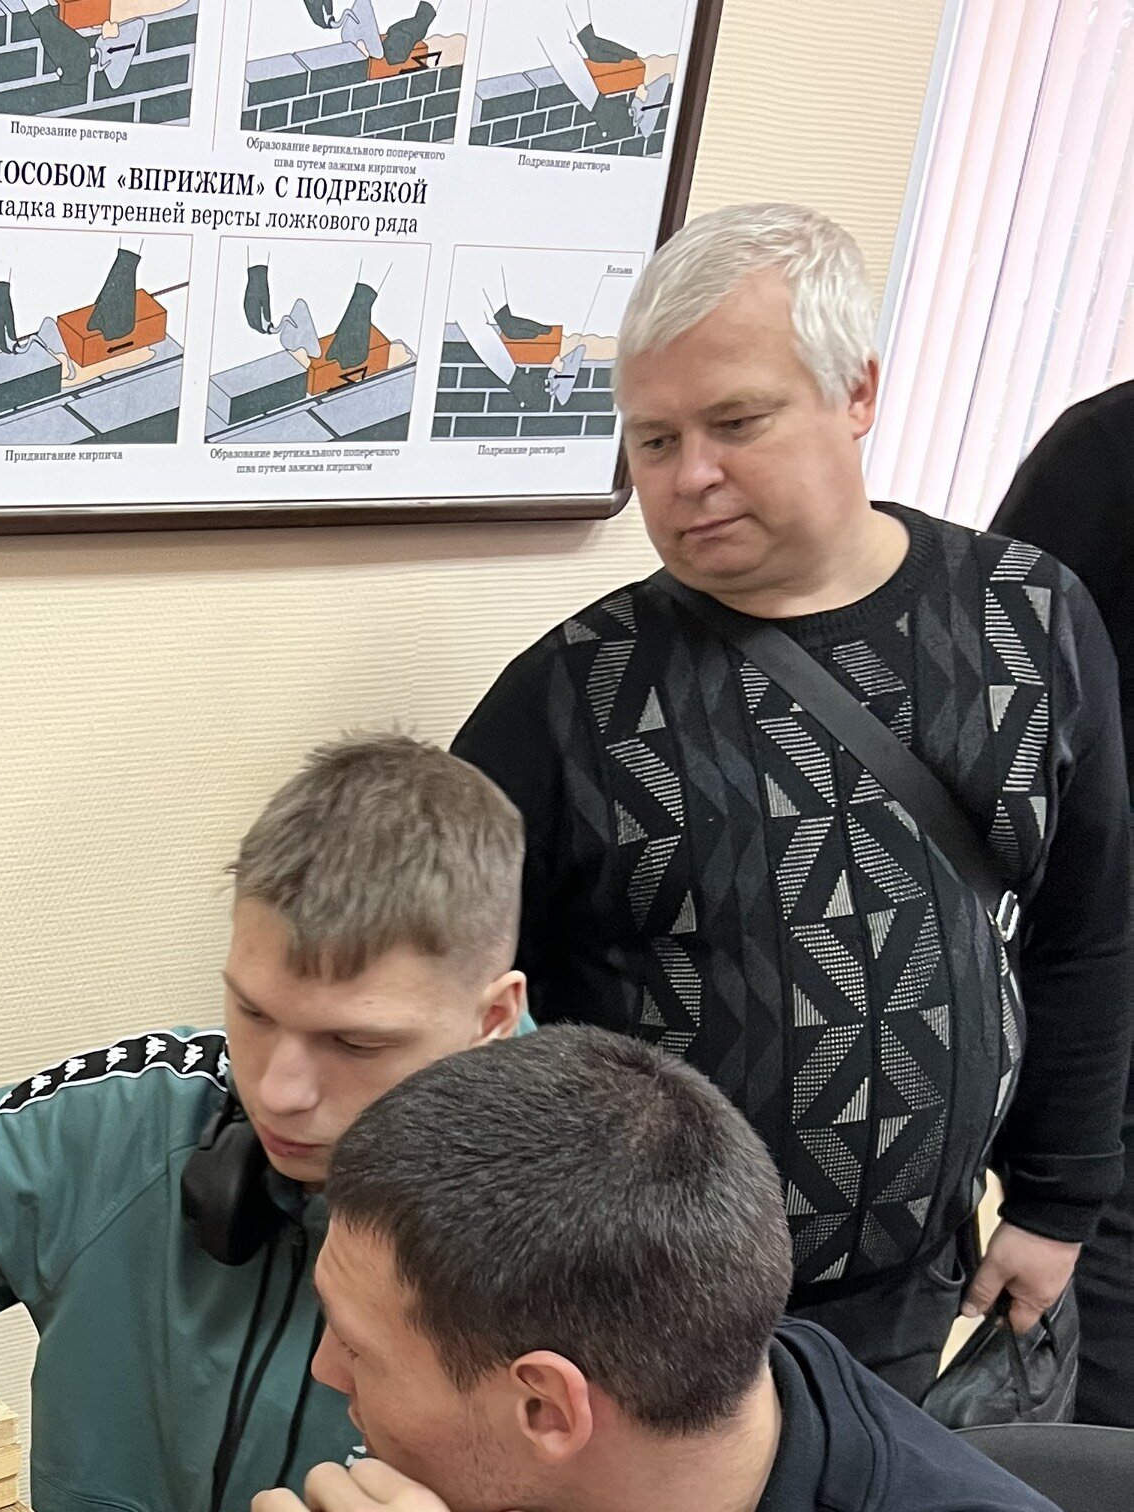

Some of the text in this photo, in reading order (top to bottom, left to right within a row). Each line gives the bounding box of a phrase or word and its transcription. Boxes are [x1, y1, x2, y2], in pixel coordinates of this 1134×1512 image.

[10, 120, 128, 143] Подрезание раствора
[246, 136, 446, 161] Образование вертикального поперечного
[274, 158, 417, 176] шва путем зажима кирпичом
[518, 154, 611, 173] Подрезание раствора
[117, 167, 265, 196] «ВПРИЖИМ»
[275, 175, 289, 198] С
[296, 176, 428, 206] ПОДРЕЗКОЙ
[62, 201, 185, 226] внутренней
[191, 207, 260, 231] версты
[266, 211, 370, 231] ложкового
[374, 214, 418, 237] ряда
[5, 449, 123, 463] Придвигание кирпича
[210, 448, 400, 461] Образование вертикального поперечного
